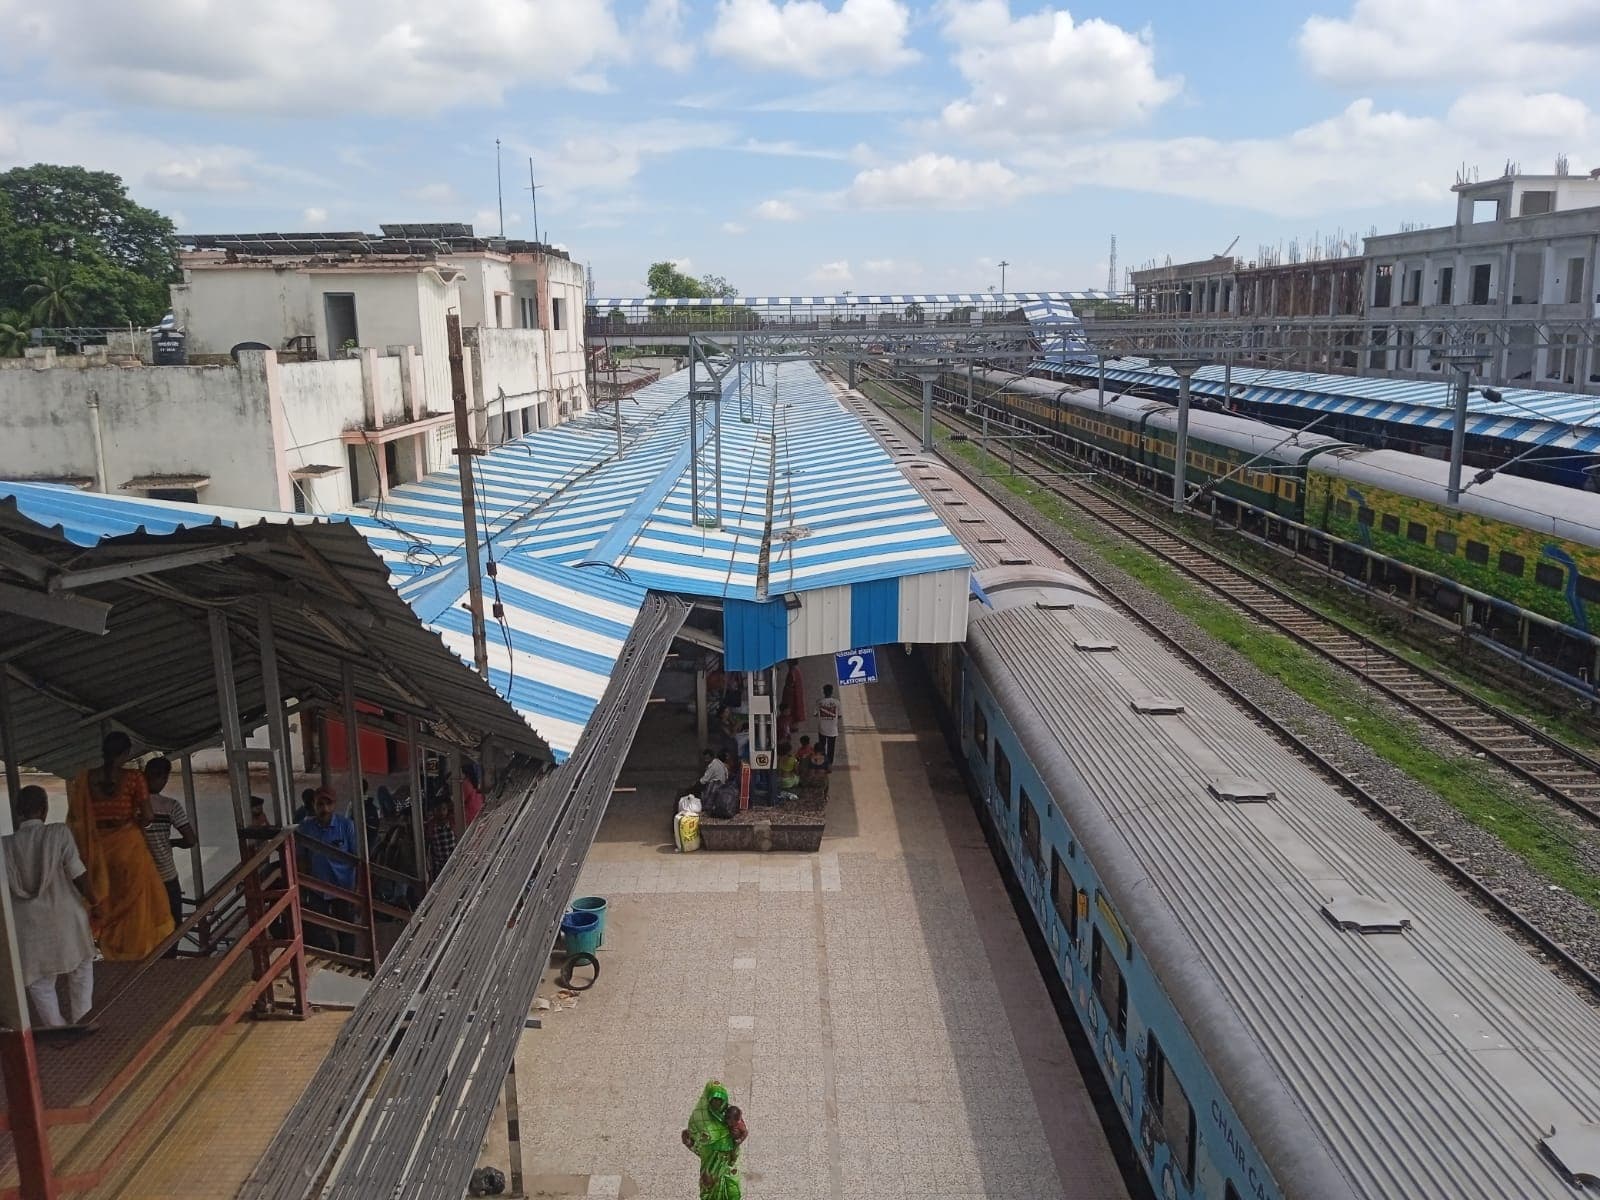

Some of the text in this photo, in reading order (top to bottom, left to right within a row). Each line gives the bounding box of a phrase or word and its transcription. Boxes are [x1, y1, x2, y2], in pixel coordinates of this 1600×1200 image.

[847, 655, 866, 679] 2
[839, 677, 867, 686] PLATFORM
[1211, 1099, 1271, 1200] CHAIR CA
